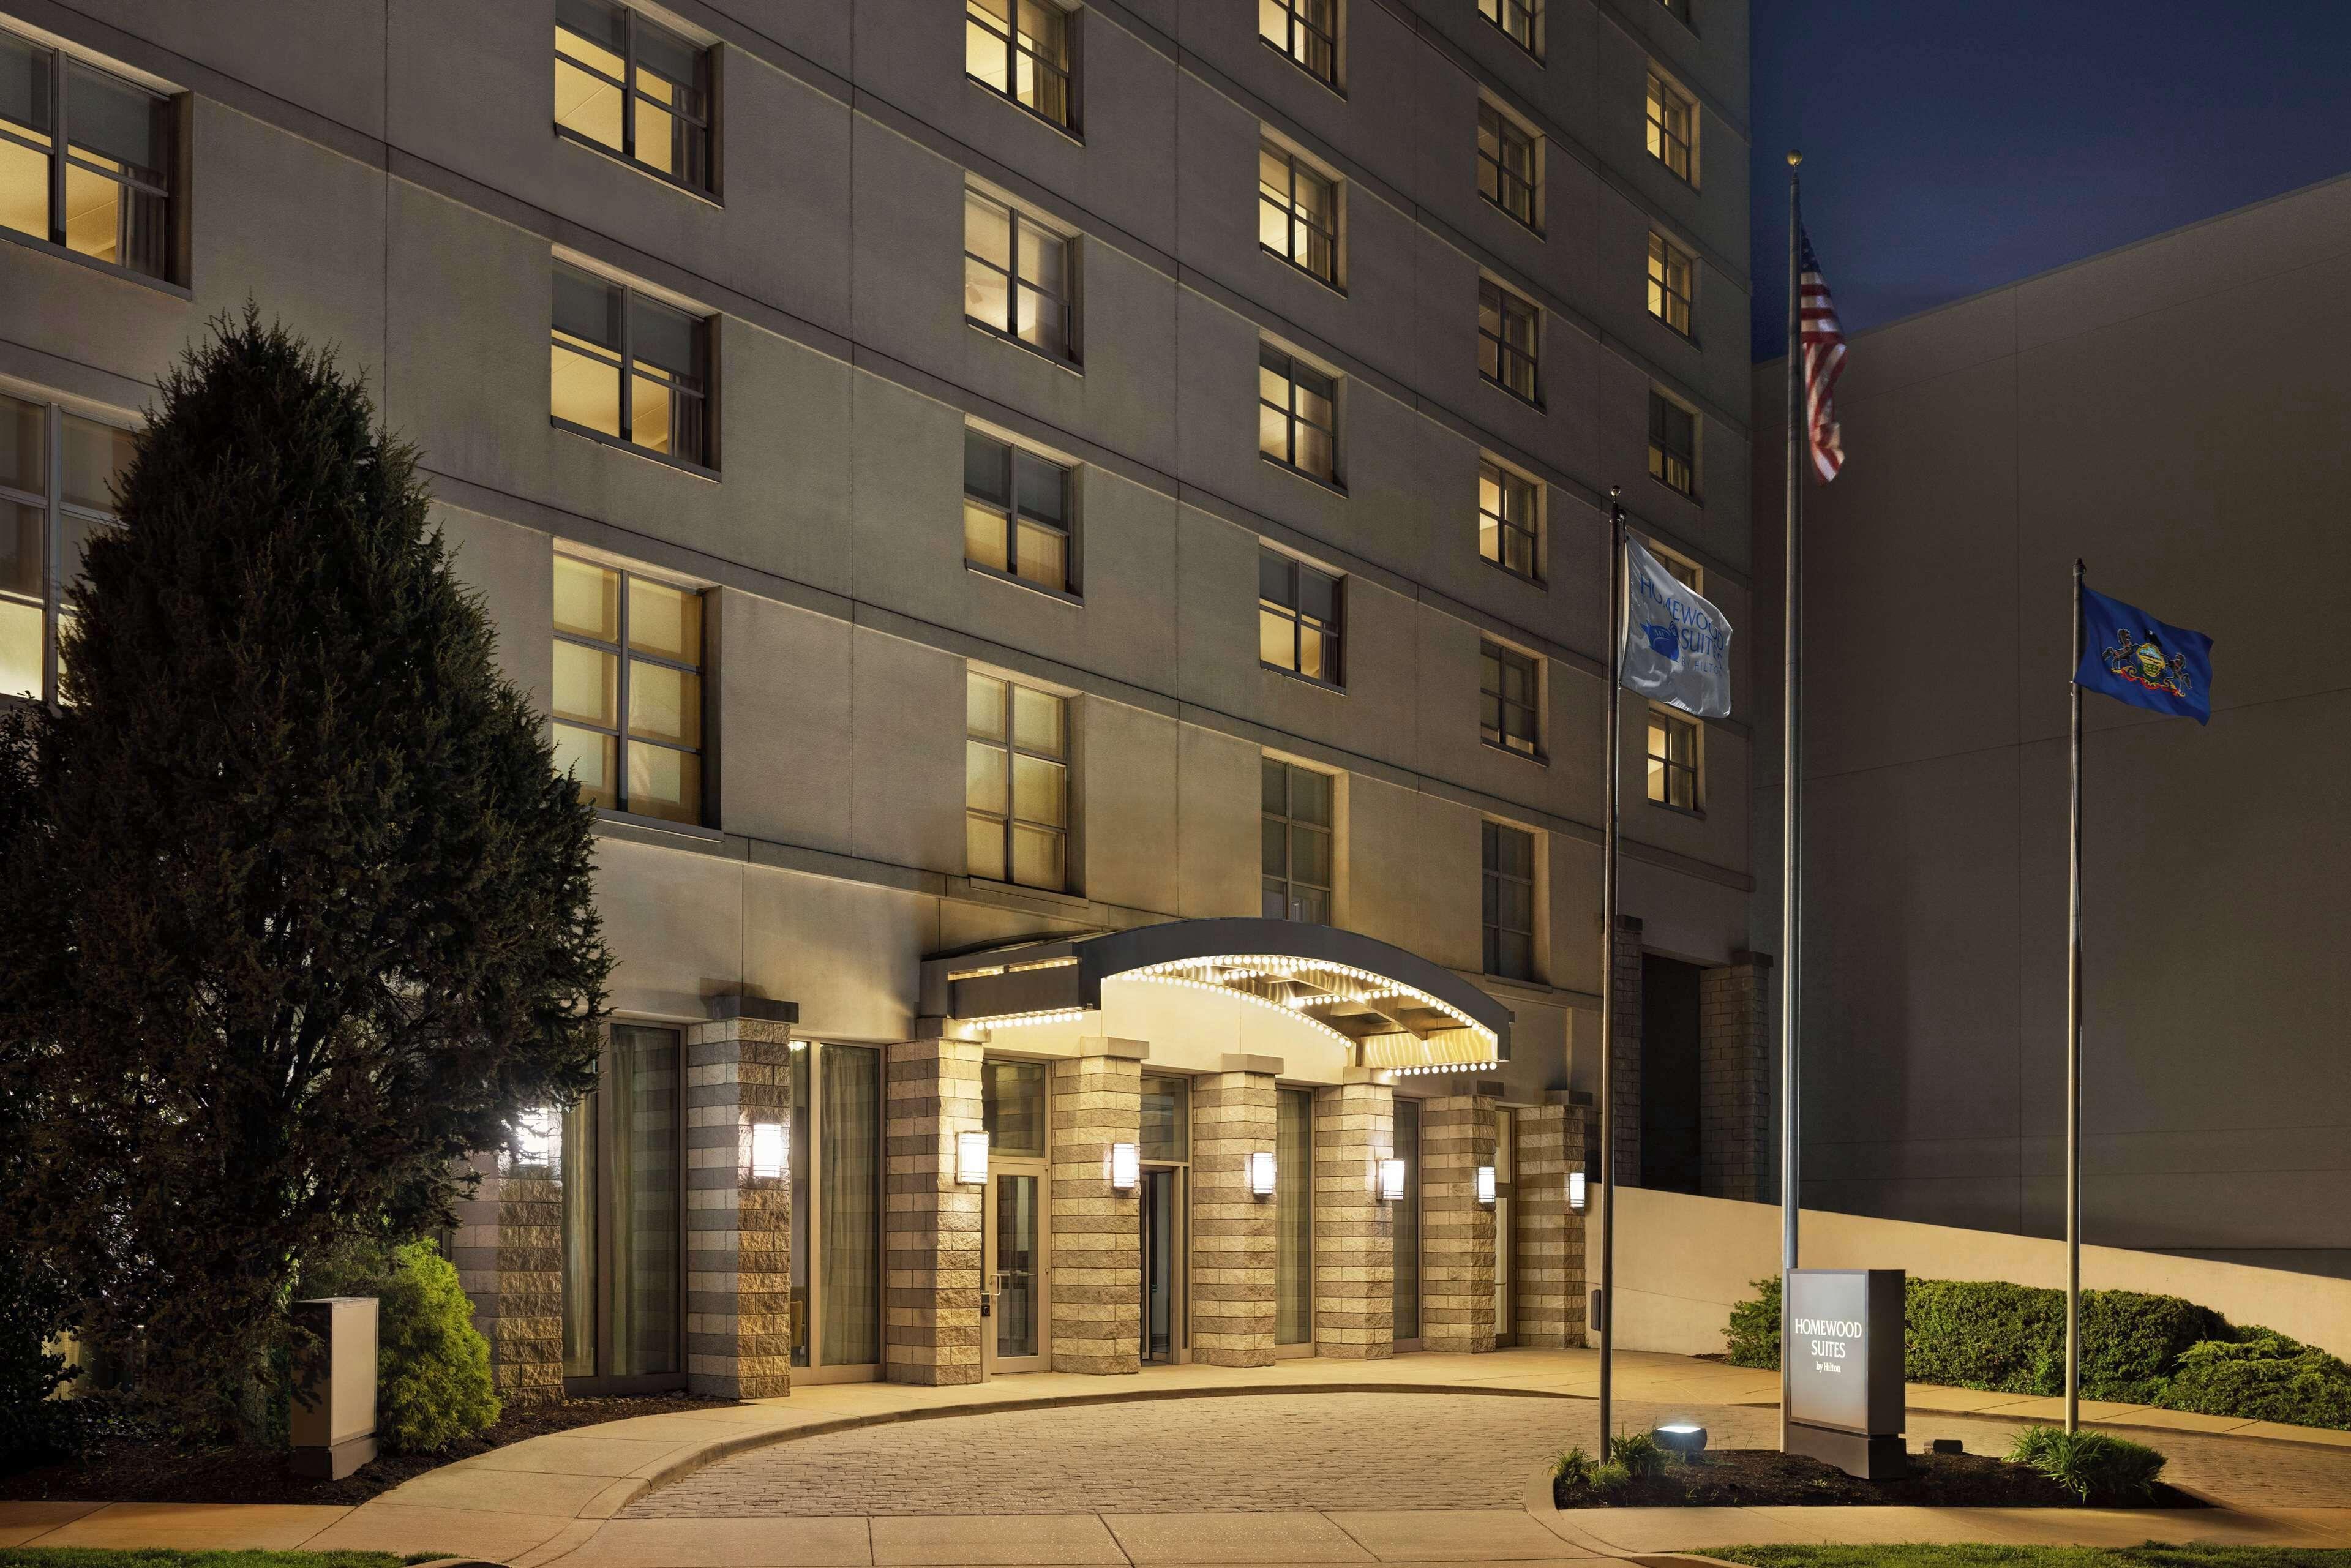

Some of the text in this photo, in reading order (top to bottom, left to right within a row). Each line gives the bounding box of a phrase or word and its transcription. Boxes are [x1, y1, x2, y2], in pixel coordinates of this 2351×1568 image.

[1795, 1318, 1862, 1338] HOMEWOOD
[1811, 1340, 1846, 1358] SUITES
[1816, 1360, 1841, 1373] by Hilton
